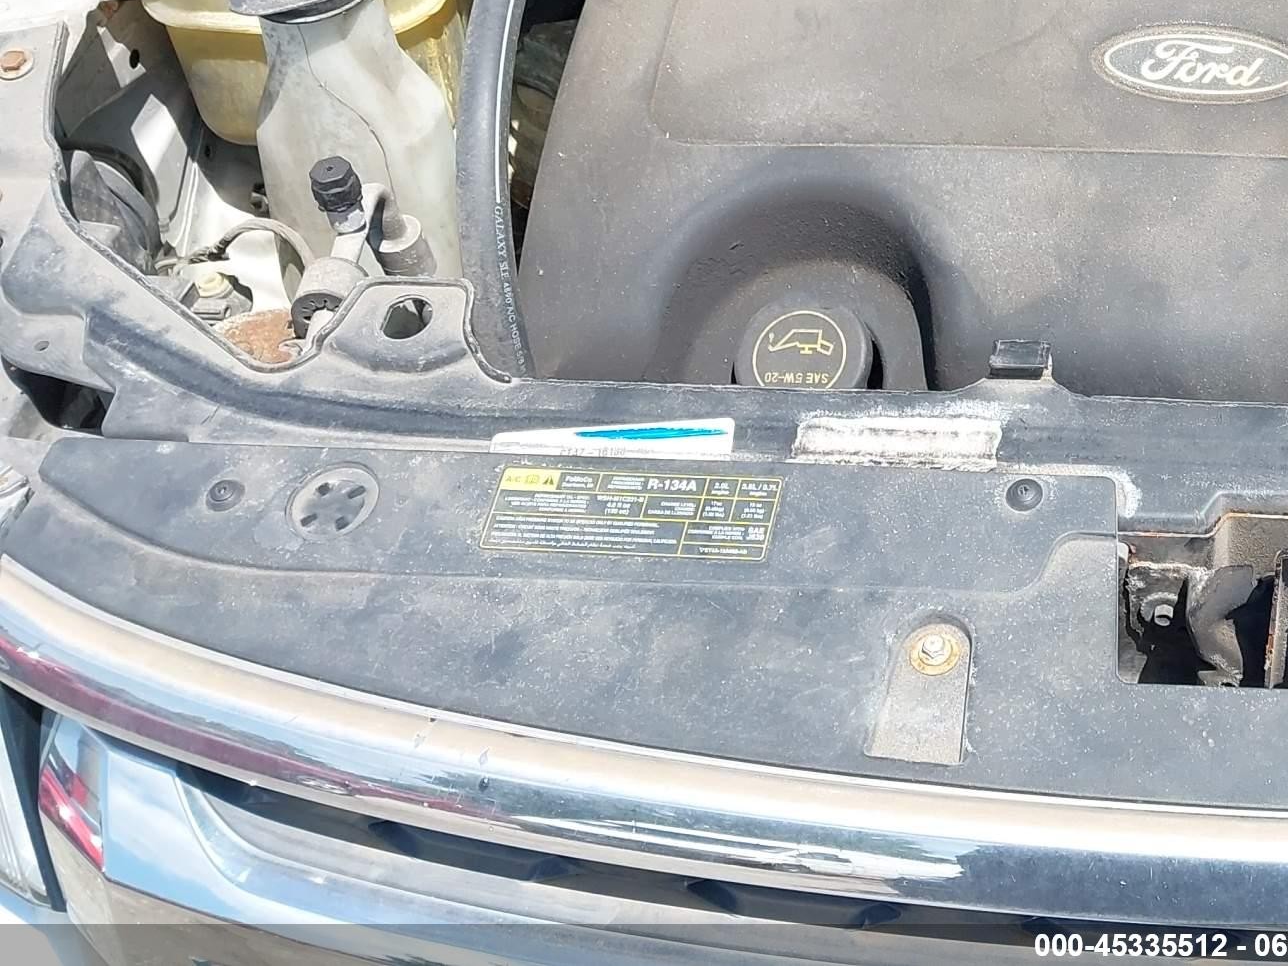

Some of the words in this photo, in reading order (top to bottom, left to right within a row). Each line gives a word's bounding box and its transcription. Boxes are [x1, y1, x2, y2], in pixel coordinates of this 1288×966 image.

[1140, 39, 1264, 87] Ford
[493, 205, 508, 259] GALAXY
[510, 322, 523, 350] HOSE
[764, 372, 804, 384] 5W-20
[805, 372, 830, 384] SAE
[646, 478, 697, 492] R-134A
